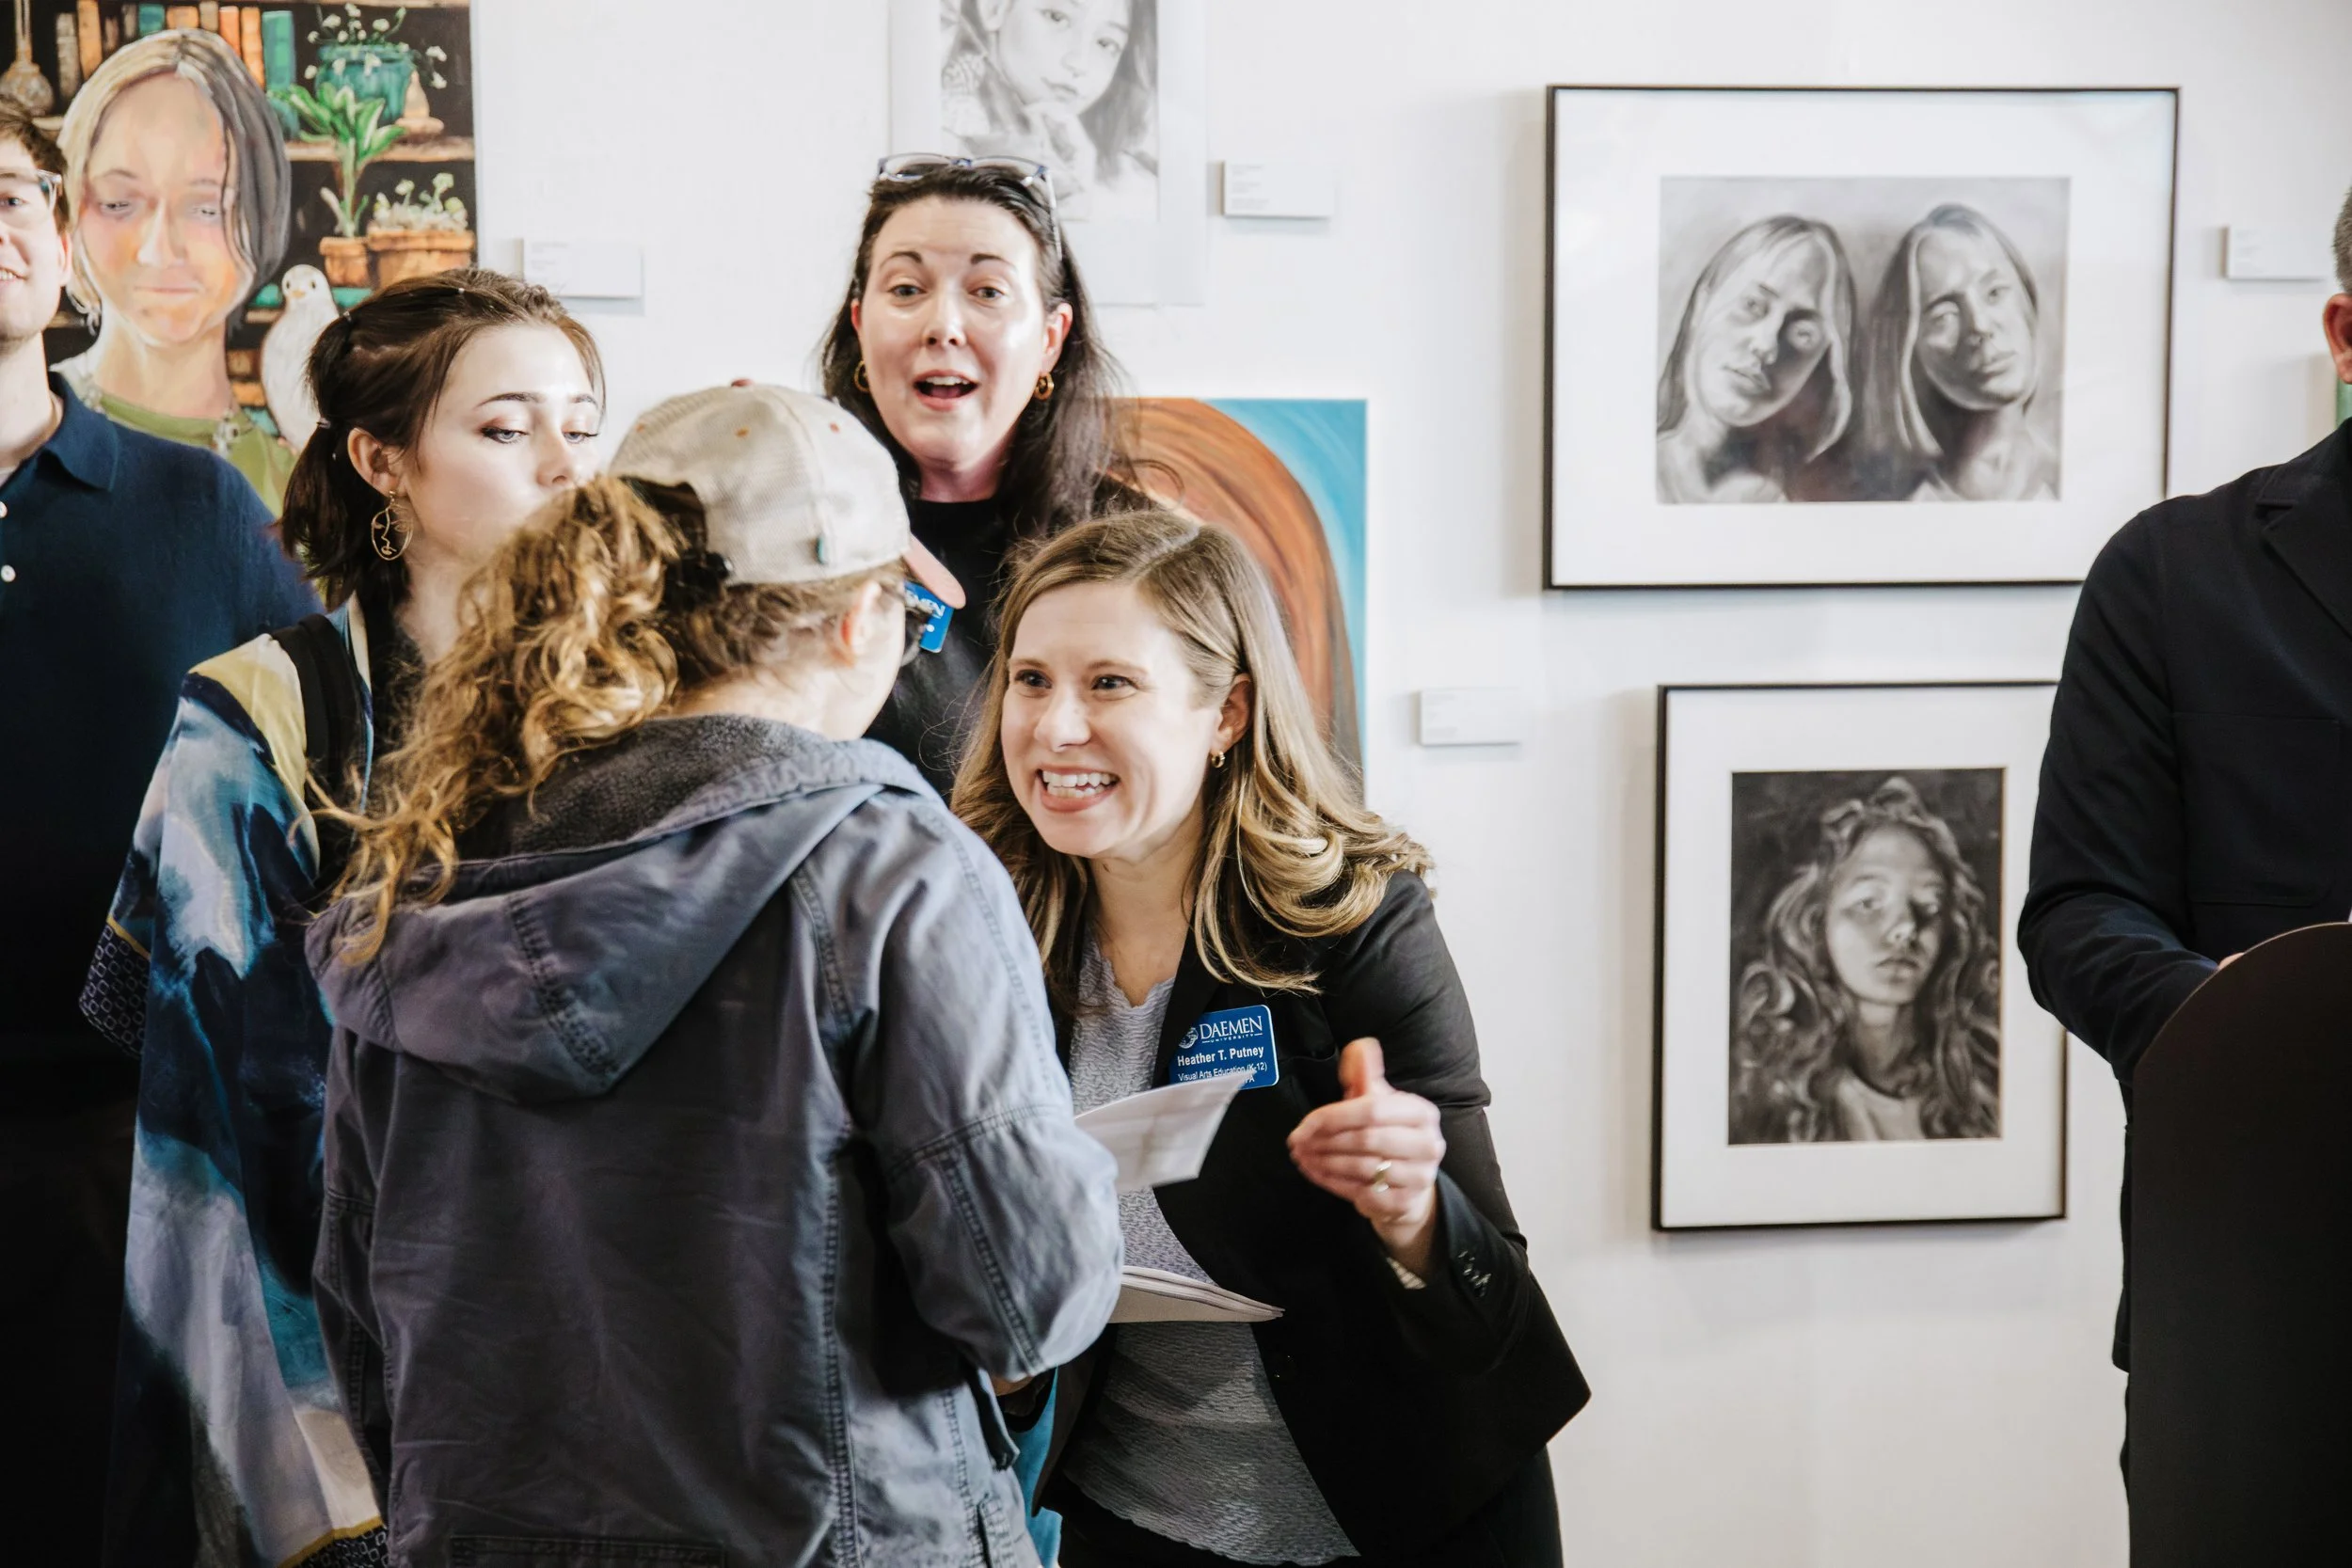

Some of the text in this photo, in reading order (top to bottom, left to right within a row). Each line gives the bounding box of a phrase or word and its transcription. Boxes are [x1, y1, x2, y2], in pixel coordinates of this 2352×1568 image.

[1200, 1016, 1263, 1040] DAEMEN
[1177, 1046, 1264, 1067] Heather T. Putney
[1177, 1061, 1268, 1082] Visual Arts Education (K-12)
